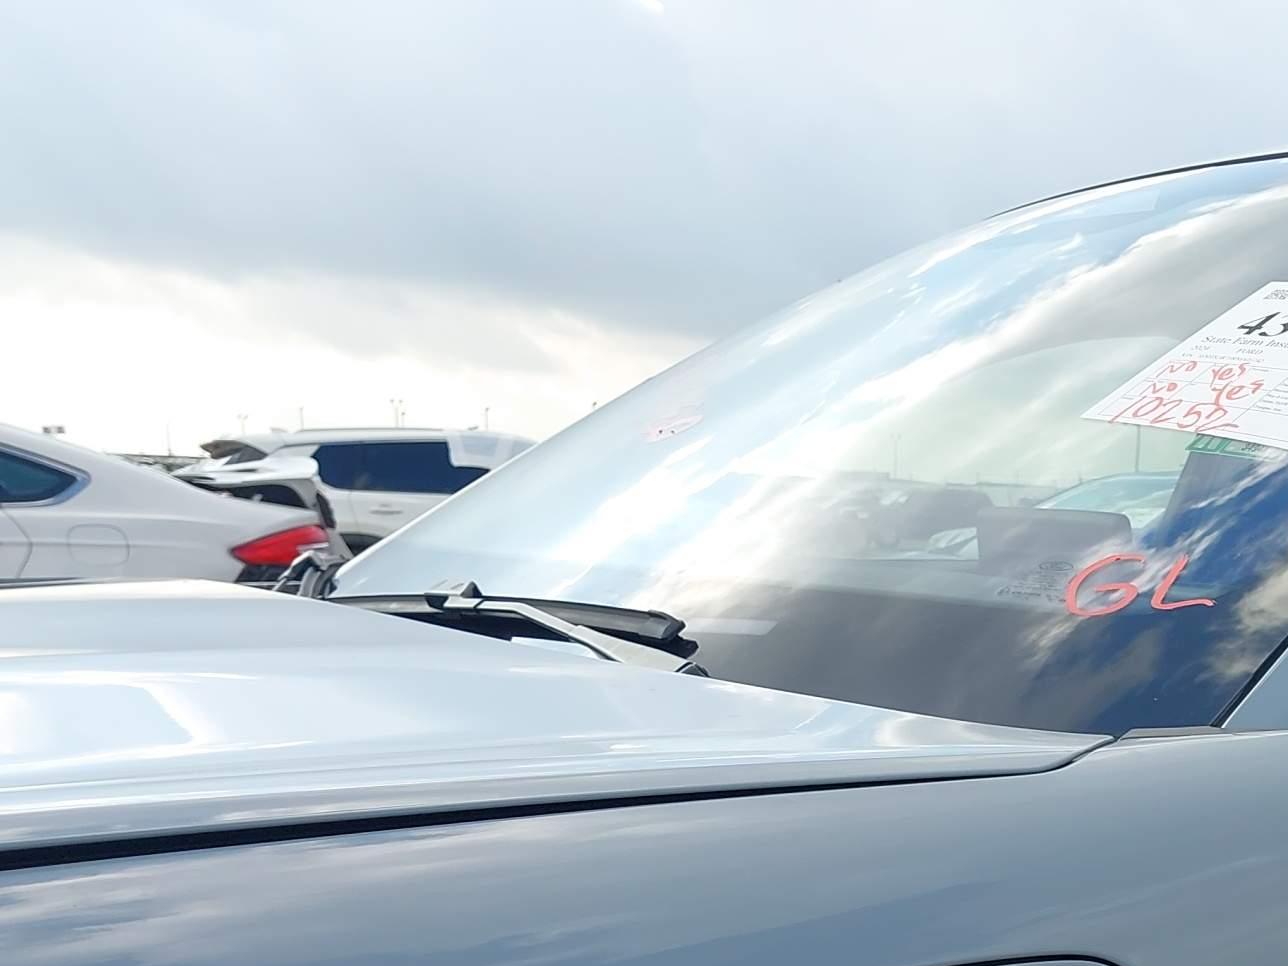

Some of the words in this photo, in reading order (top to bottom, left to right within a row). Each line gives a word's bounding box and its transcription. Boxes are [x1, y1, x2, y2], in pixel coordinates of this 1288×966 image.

[1201, 336, 1232, 345] State
[1232, 337, 1264, 346] Farm
[1108, 396, 1239, 432] 10252
[1065, 553, 1216, 617] GL
